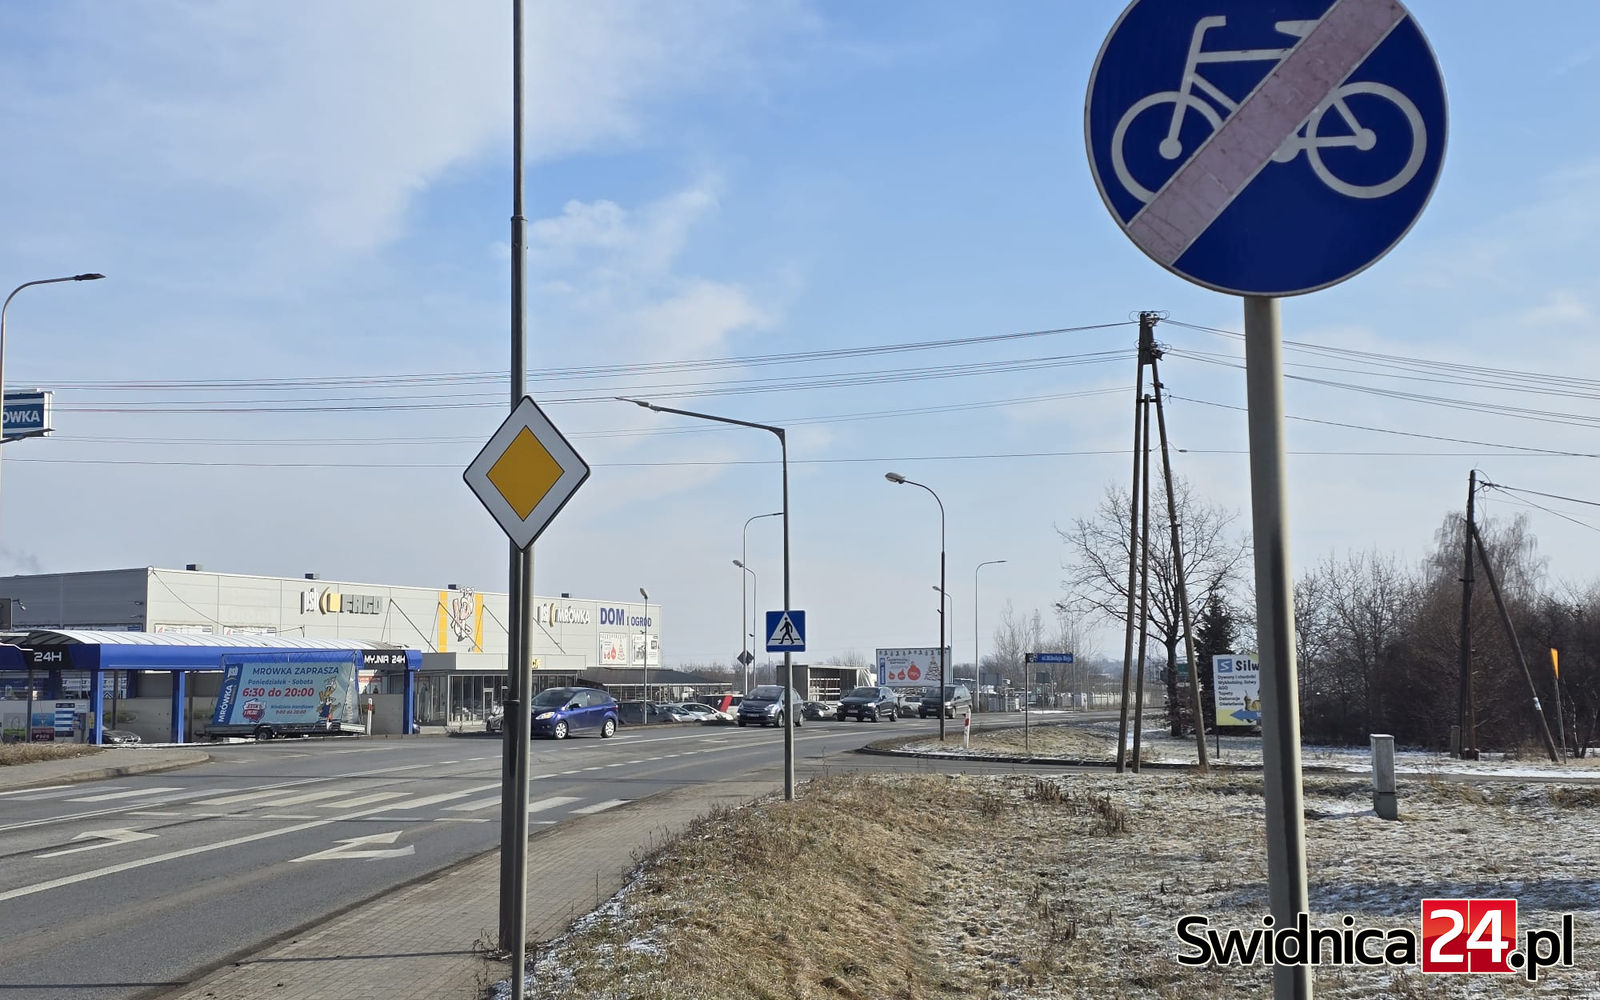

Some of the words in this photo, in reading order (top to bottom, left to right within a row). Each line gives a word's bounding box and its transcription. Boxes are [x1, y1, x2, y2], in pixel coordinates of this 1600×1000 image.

[600, 607, 625, 626] DOM
[33, 651, 62, 662] 24H
[391, 655, 406, 664] 24H
[294, 666, 339, 675] ZAPRASZA
[242, 687, 265, 697] 6:30
[268, 687, 282, 697] do
[284, 687, 315, 697] 20:00
[218, 684, 233, 722] MRÓWKA
